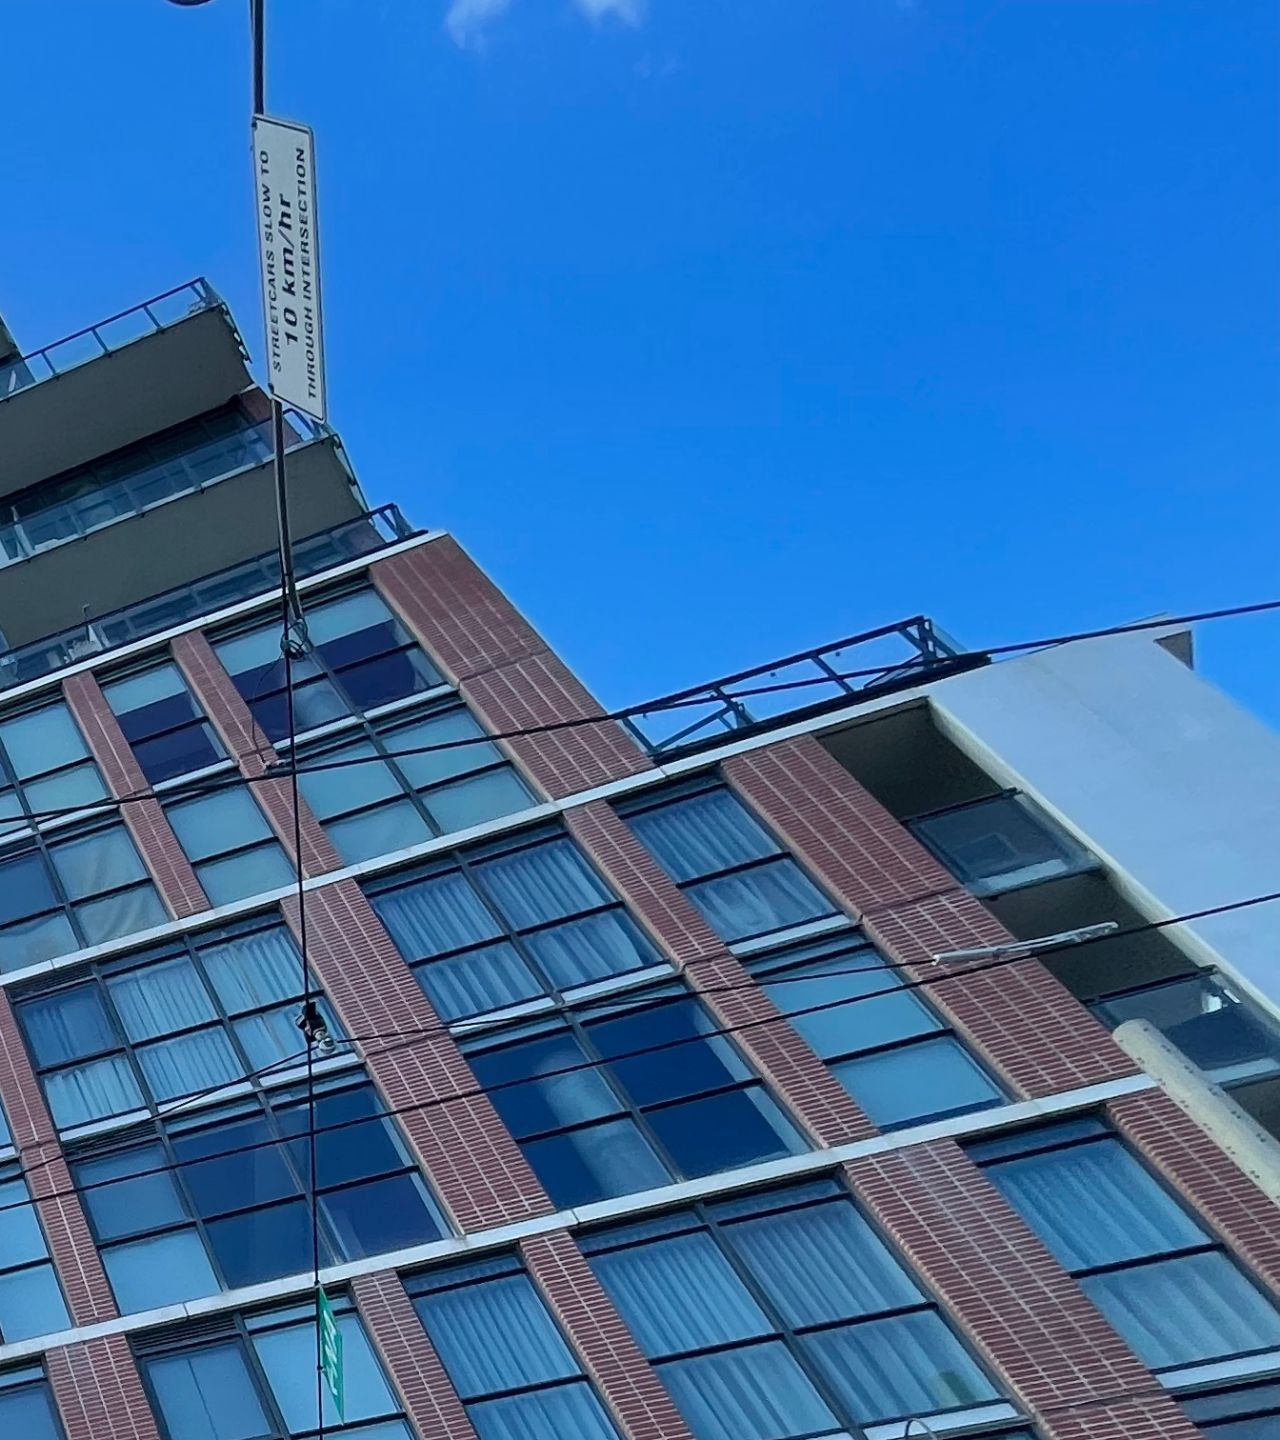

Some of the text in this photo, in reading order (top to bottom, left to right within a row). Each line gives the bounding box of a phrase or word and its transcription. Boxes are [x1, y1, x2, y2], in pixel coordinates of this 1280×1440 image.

[259, 150, 282, 373] STREETCARS SLOW TO
[277, 193, 299, 347] 10 km/hr
[296, 148, 317, 400] THROUGH INTERSECTION
